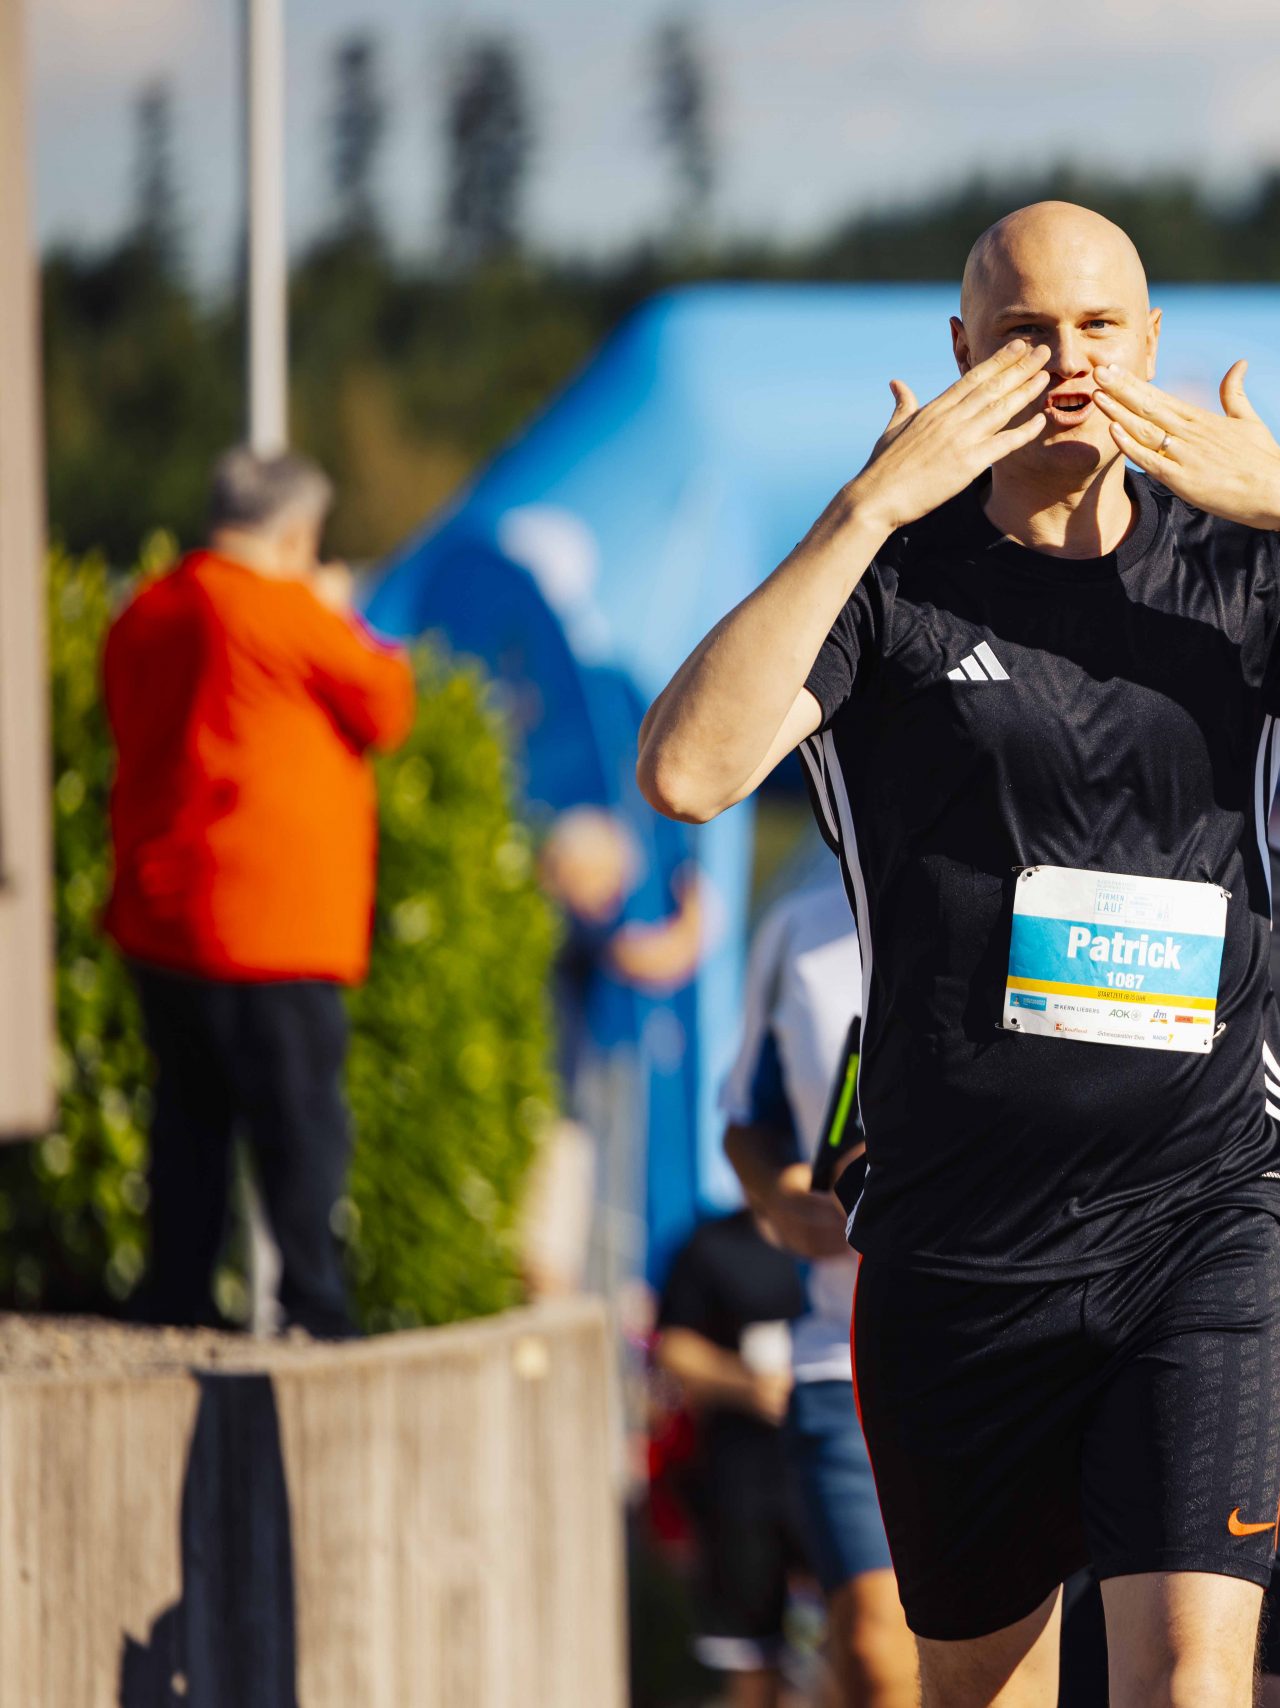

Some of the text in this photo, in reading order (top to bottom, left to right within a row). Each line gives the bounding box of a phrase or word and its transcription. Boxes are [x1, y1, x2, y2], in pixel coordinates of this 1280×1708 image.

[1097, 901, 1122, 912] LAUF
[1067, 925, 1181, 970] Patrick
[1106, 971, 1145, 989] 1087
[1108, 1008, 1130, 1019] AOK
[1152, 1009, 1167, 1019] dm
